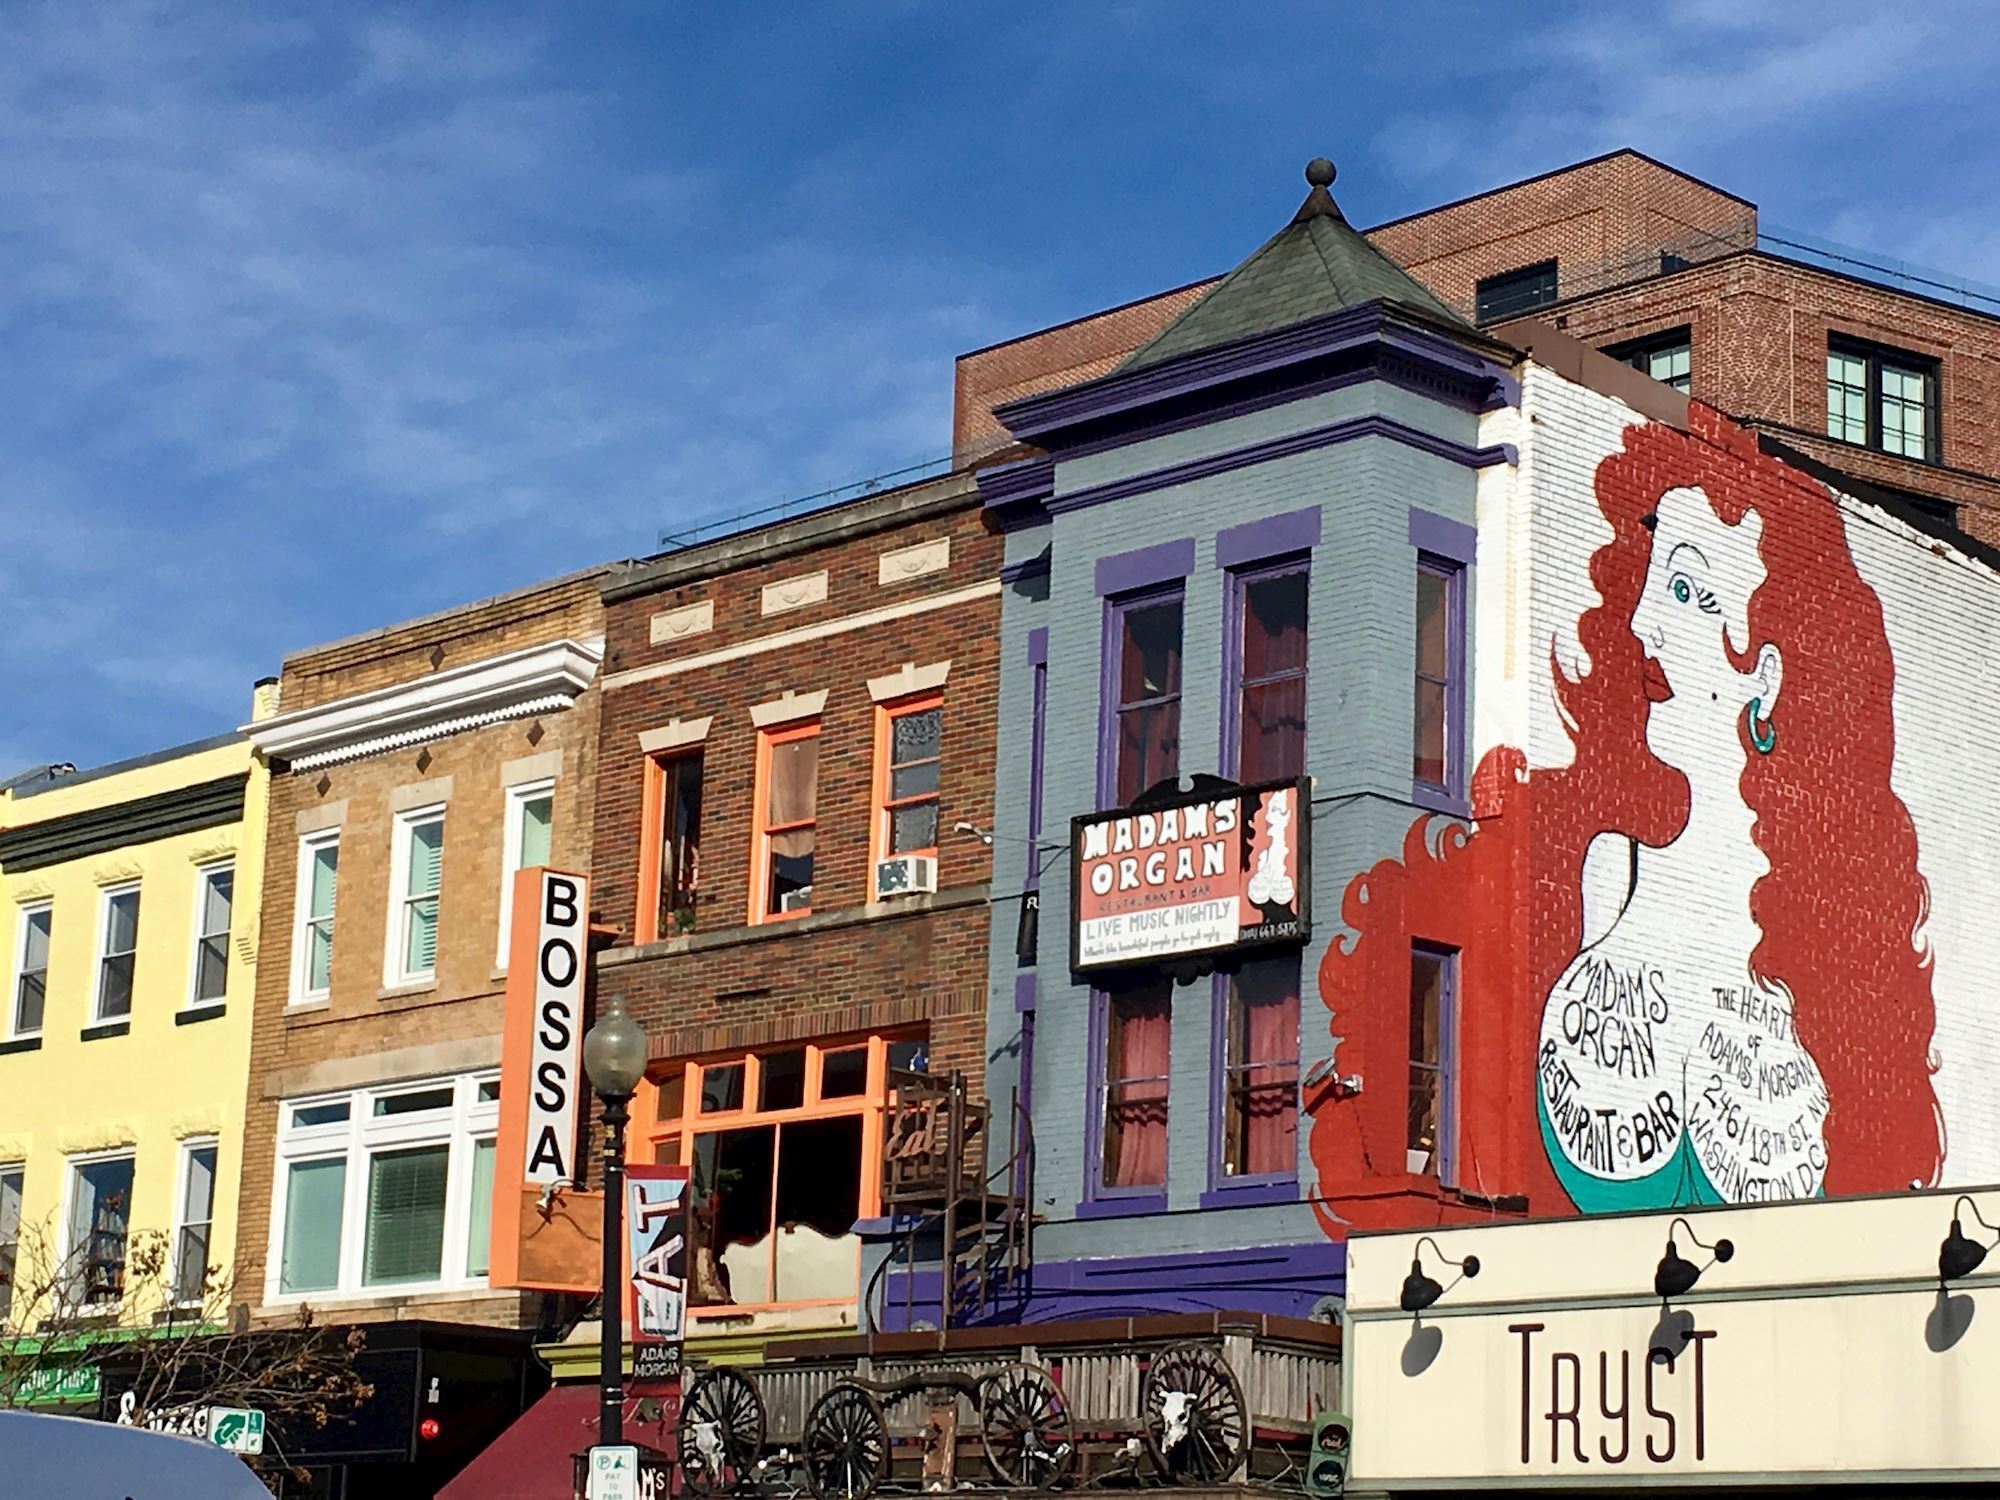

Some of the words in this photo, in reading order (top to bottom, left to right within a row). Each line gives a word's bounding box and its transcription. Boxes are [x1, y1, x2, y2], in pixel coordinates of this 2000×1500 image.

[1082, 798, 1237, 861] MADAM'S
[1090, 840, 1227, 896] ORGAN
[1086, 918, 1122, 940] LIVE
[1129, 908, 1170, 933] MUSIC
[1174, 900, 1231, 926] NIGHTLY
[1565, 954, 1668, 1024] MADAM'S
[1712, 987, 1738, 1011] THE
[1740, 984, 1794, 1041] HEART
[528, 876, 579, 1178] BOSSA
[1563, 1000, 1656, 1079] ORGAN
[1747, 1034, 1763, 1058] OF
[1700, 1021, 1752, 1089] ADAMS
[1758, 1055, 1815, 1104] MORGAN
[1541, 1037, 1616, 1174] RESTAURANT
[1632, 1090, 1680, 1164] BAR
[1703, 1074, 1750, 1146] 2461
[1750, 1126, 1786, 1166] 18TH
[1689, 1101, 1796, 1203] WASHINGTON
[634, 1361, 681, 1378] MORGAN
[639, 1346, 679, 1362] ADAMS
[1508, 1322, 1717, 1464] TRYST
[605, 1473, 621, 1481] PAY
